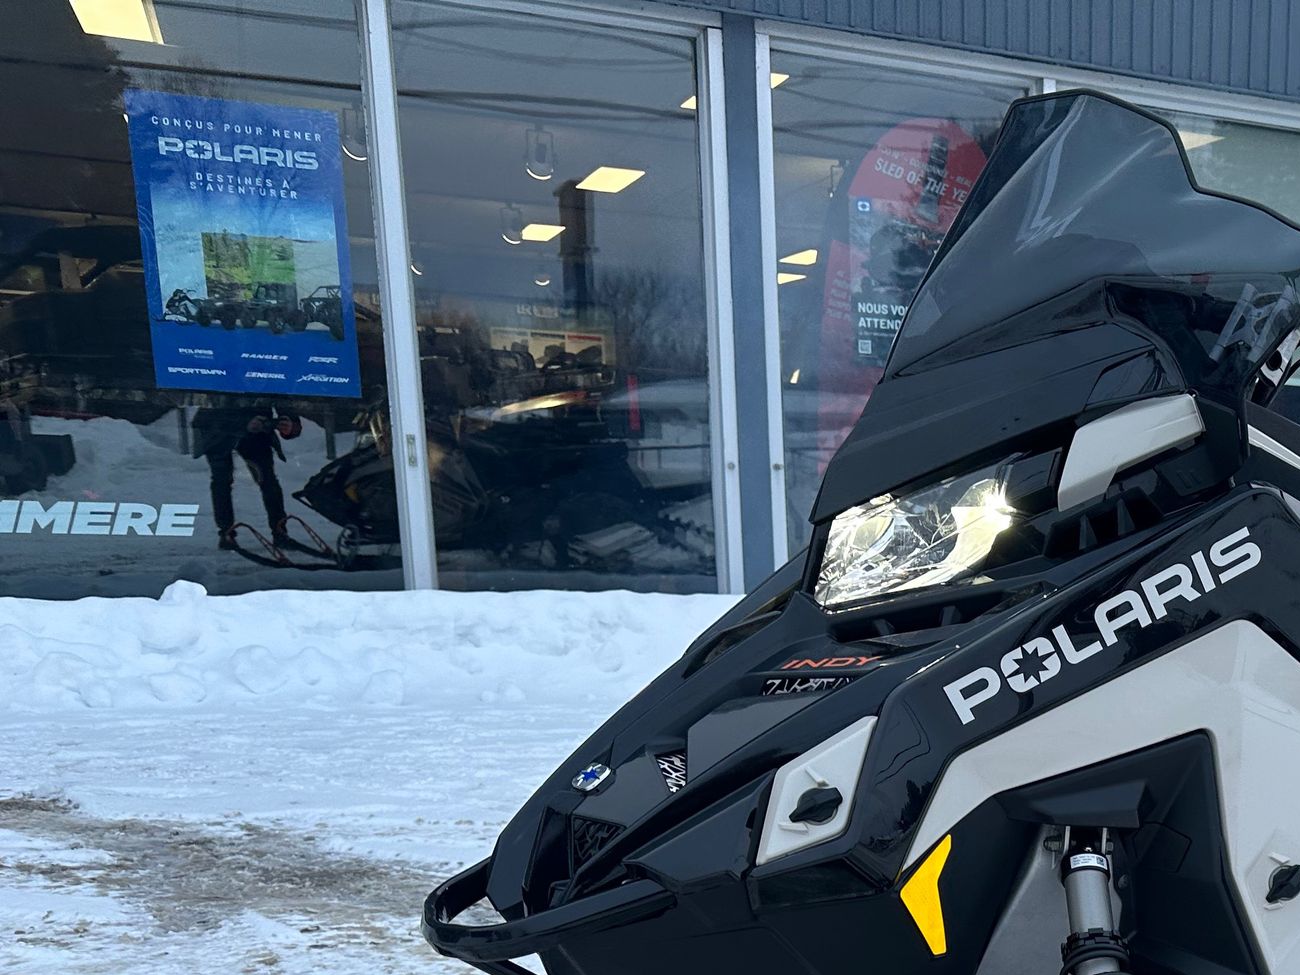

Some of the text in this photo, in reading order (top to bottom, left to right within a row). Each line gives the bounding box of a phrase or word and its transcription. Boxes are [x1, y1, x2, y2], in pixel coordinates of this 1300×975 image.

[151, 116, 322, 142] CONÇUS POUR MENER
[157, 136, 319, 170] POLARIS
[874, 158, 905, 180] SLED
[906, 170, 923, 186] OF
[925, 176, 949, 196] THE
[952, 188, 969, 202] YE
[189, 181, 298, 199] S'AVENTURER
[857, 302, 909, 316] NOUS VO
[858, 317, 903, 330] ATTEND
[240, 352, 289, 361] RANGER
[167, 366, 227, 376] SPORTSMAN
[244, 371, 287, 380] GENERAL
[296, 373, 350, 383] XPEDITION
[943, 526, 1262, 725] POLARIS
[781, 655, 884, 670] INDY
